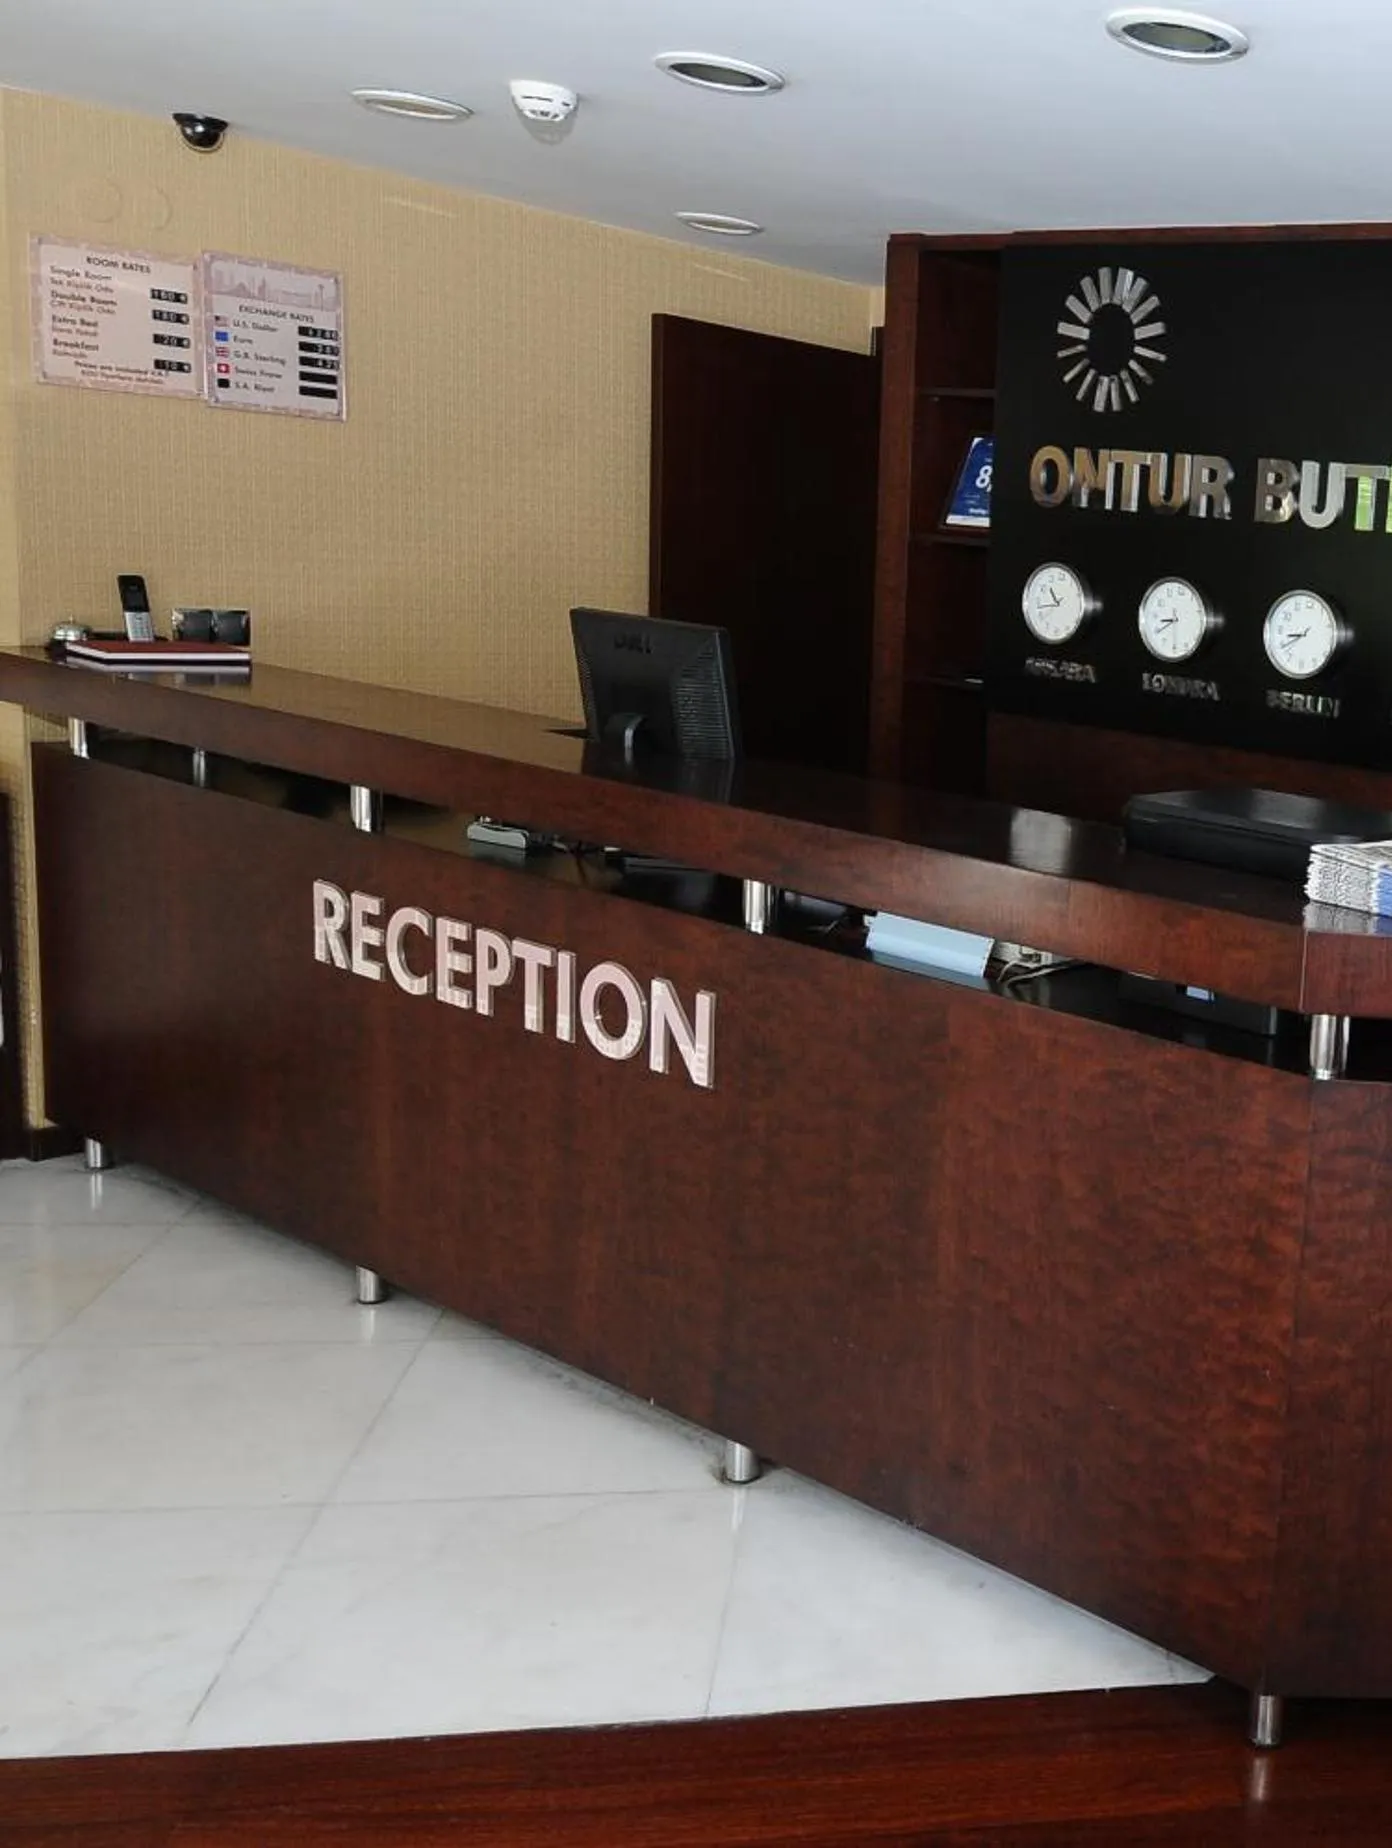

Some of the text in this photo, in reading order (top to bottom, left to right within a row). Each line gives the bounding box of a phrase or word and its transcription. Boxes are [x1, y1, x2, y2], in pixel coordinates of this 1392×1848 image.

[50, 265, 80, 278] Single
[86, 256, 151, 274] ROOM RATES
[51, 290, 86, 302] Double
[239, 305, 314, 323] EXCHANGE RATES
[53, 338, 99, 351] Breakfast
[1029, 446, 1233, 520] ONTUR
[1265, 689, 1341, 719] BERLIN
[312, 879, 717, 1089] RECEPTION
